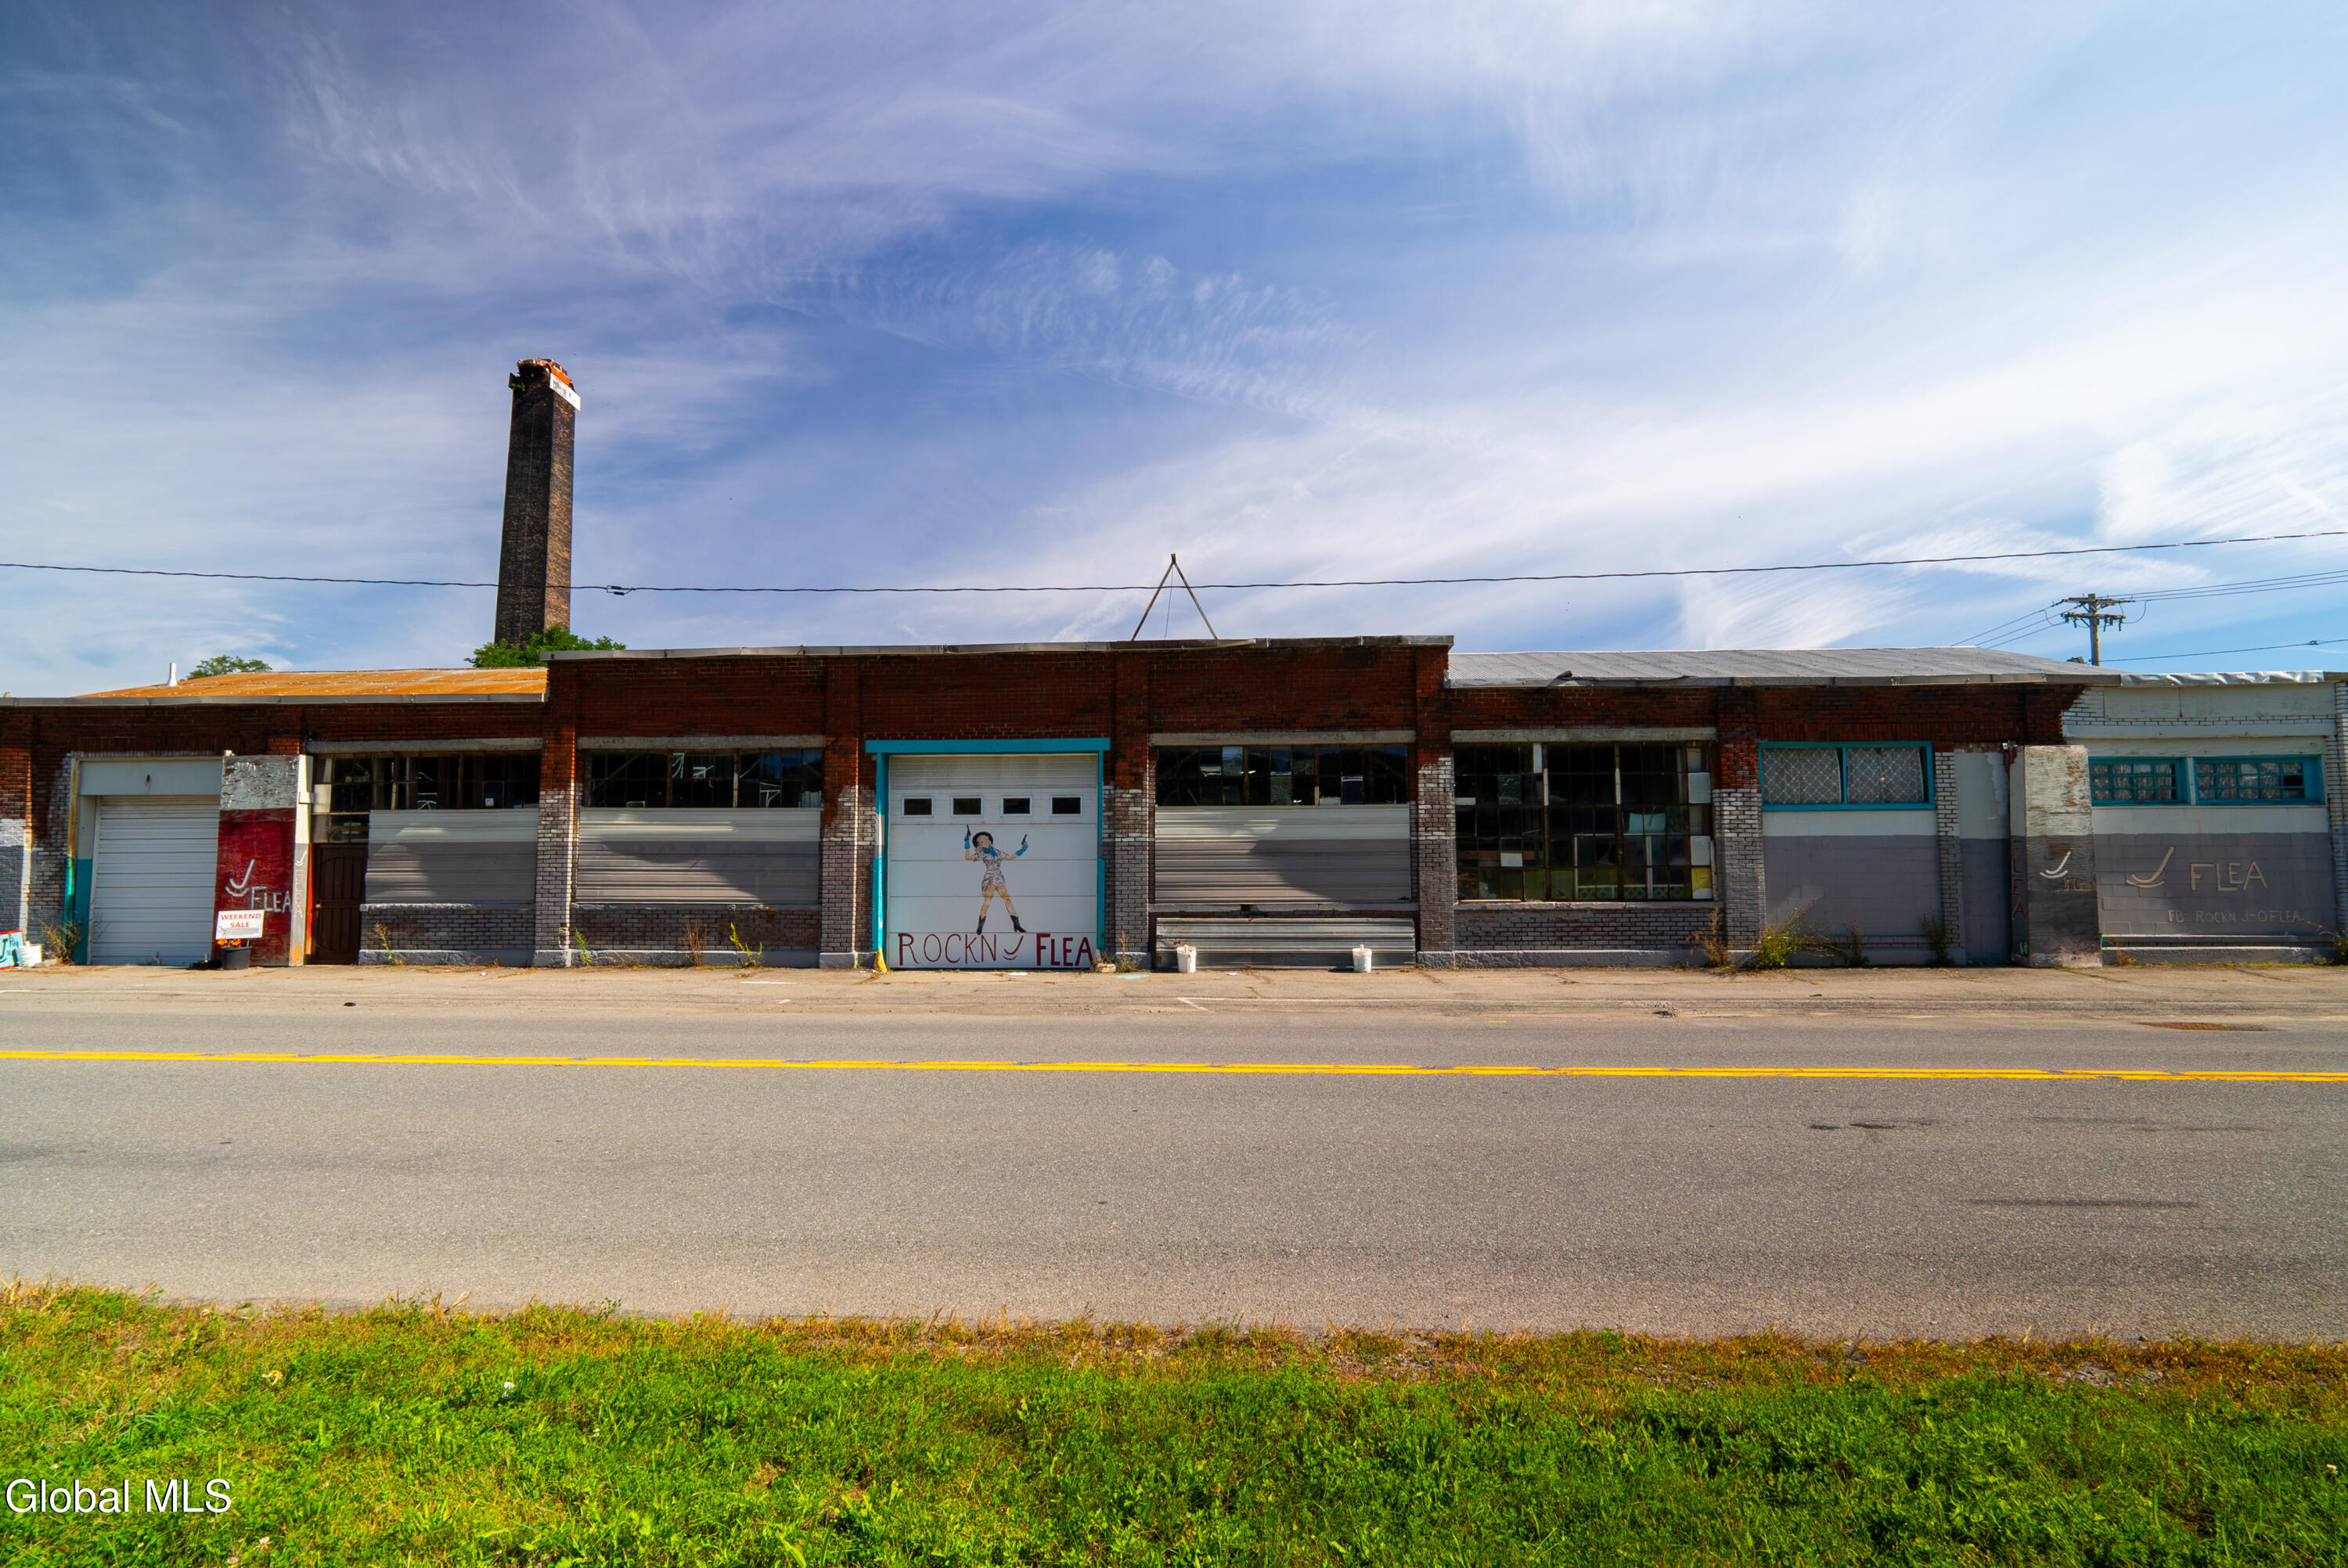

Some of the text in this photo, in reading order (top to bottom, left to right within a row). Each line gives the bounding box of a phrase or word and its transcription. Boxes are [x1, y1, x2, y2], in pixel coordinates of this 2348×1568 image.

[2190, 860, 2267, 891] FLEA
[250, 886, 292, 914] FLEA
[898, 933, 996, 966] ROCKN
[1036, 933, 1094, 966] FLEA
